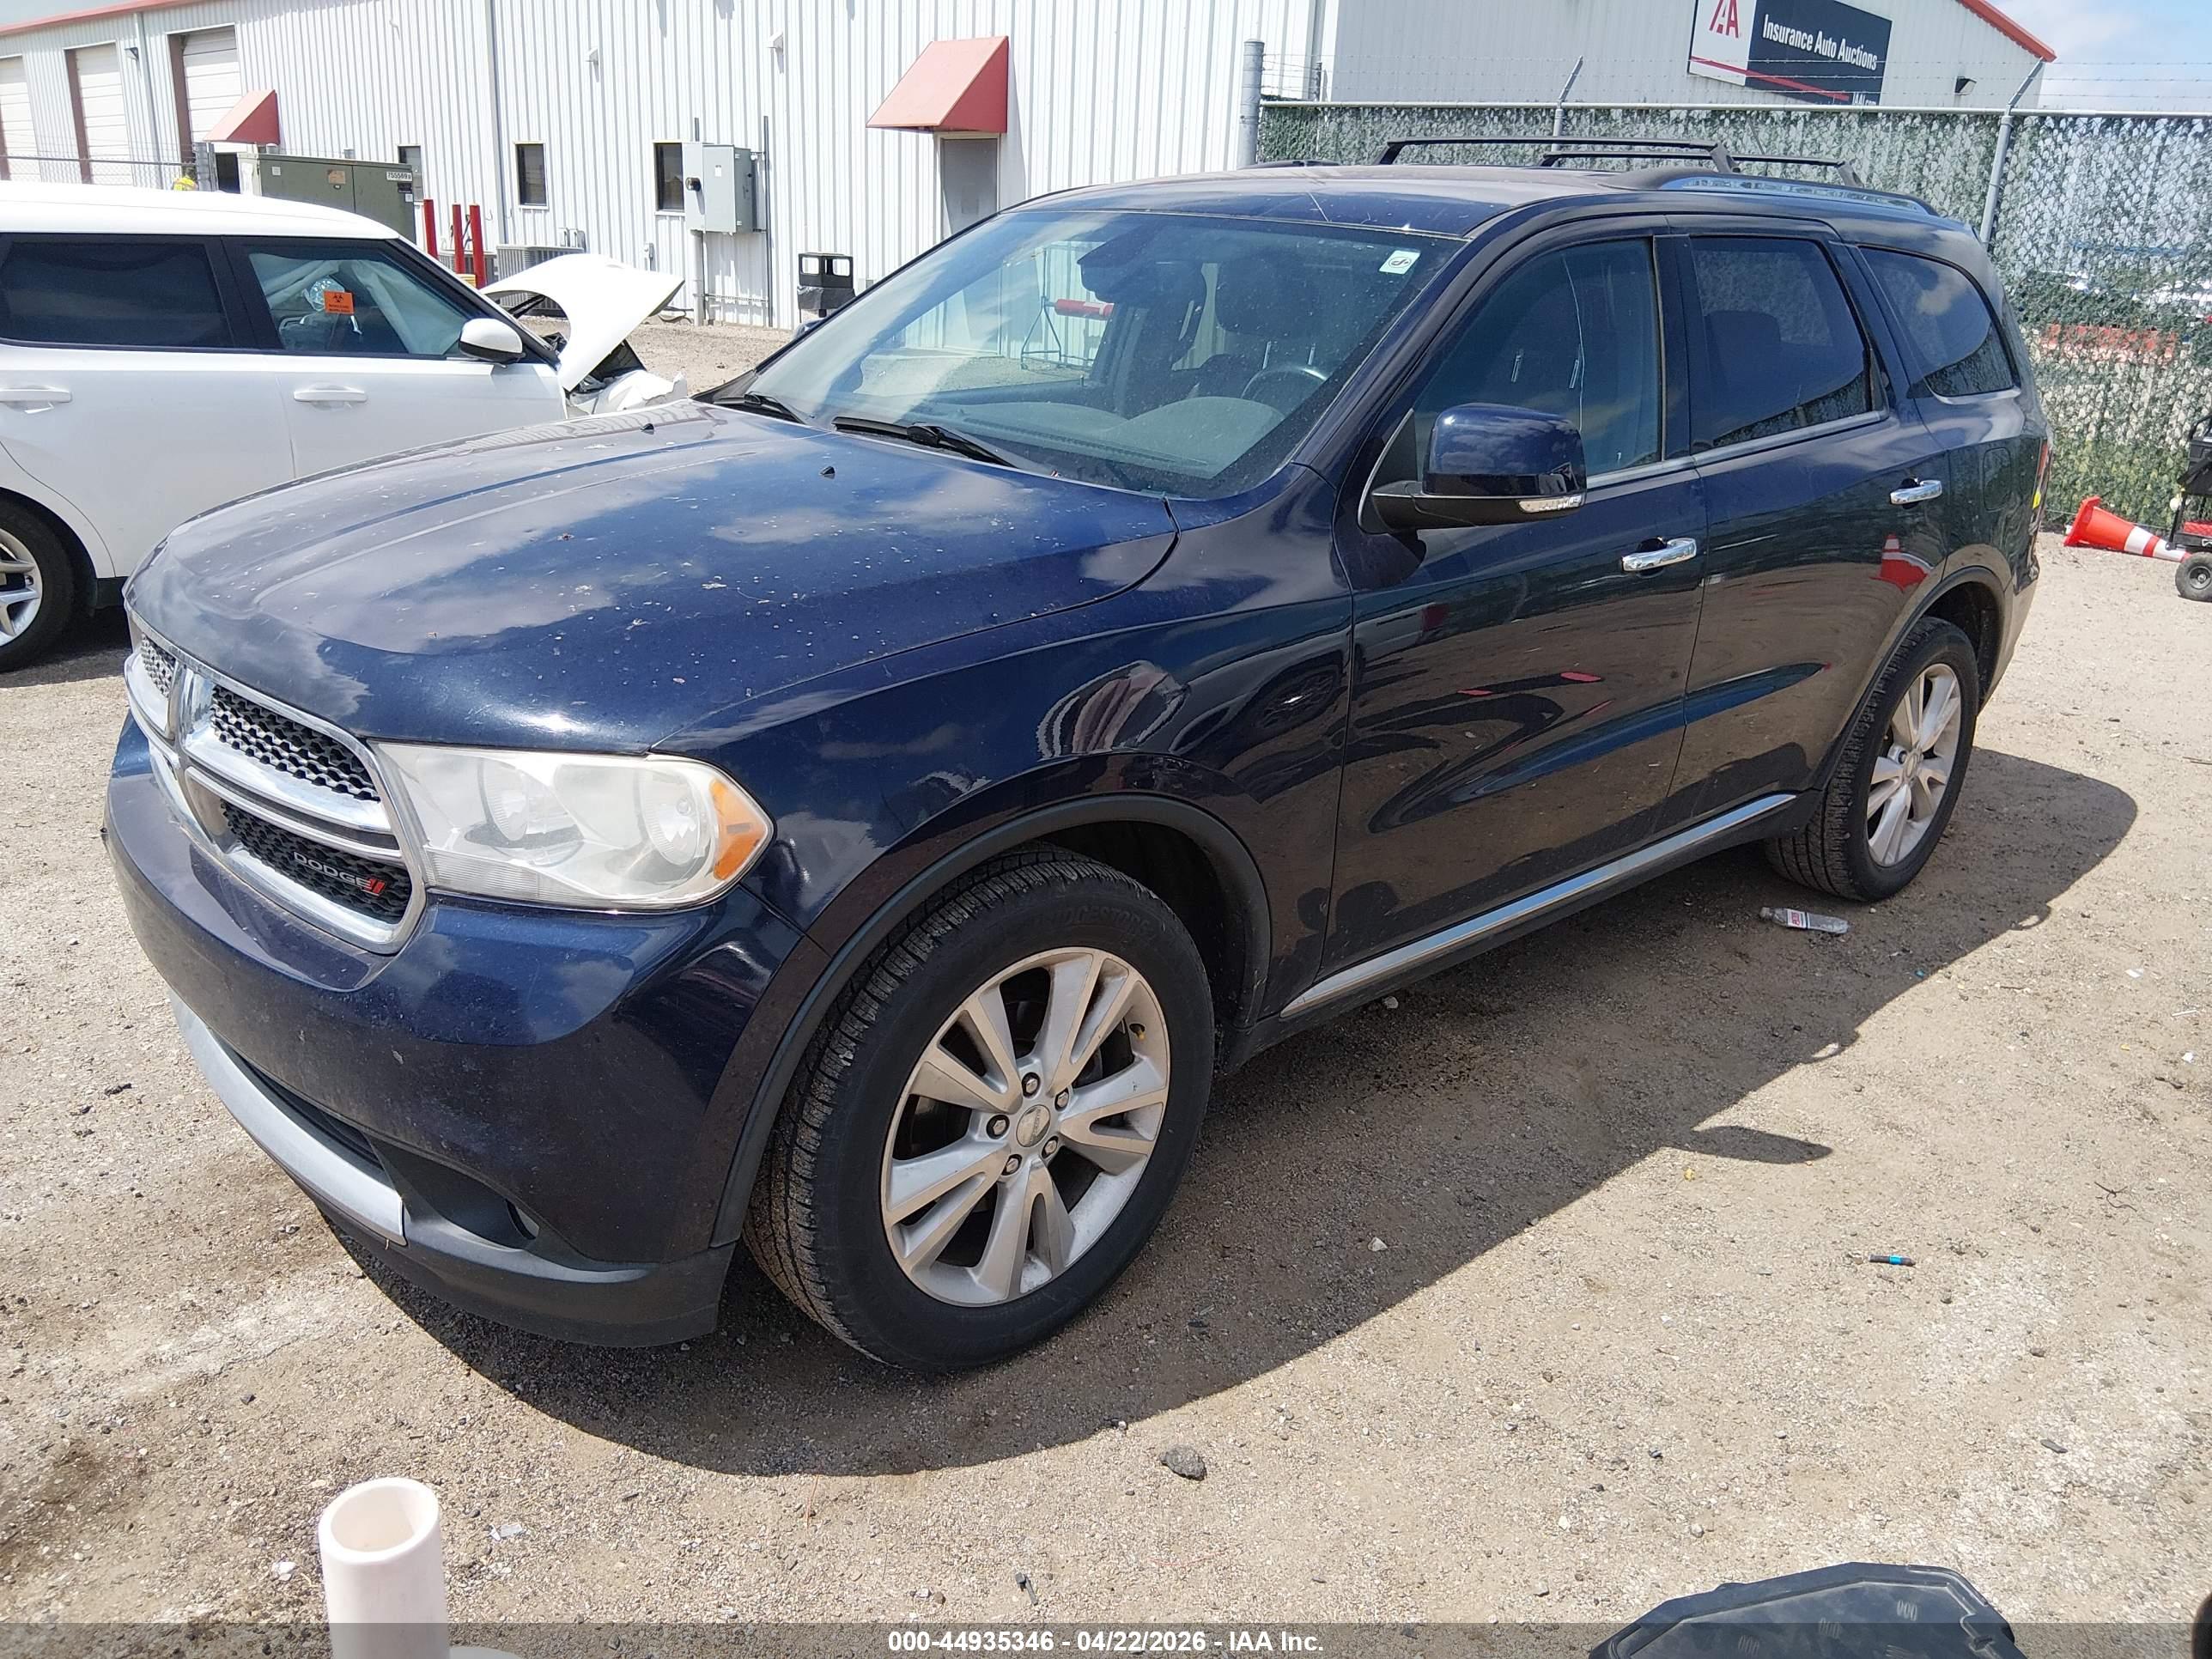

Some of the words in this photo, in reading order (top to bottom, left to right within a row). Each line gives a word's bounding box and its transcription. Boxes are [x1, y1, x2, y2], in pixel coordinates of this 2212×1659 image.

[1763, 14, 1813, 52] Insurance
[1814, 31, 1837, 58] Auto
[1838, 39, 1877, 70] Auctions
[1852, 92, 1877, 106] IAAI
[294, 851, 373, 890] DODGE
